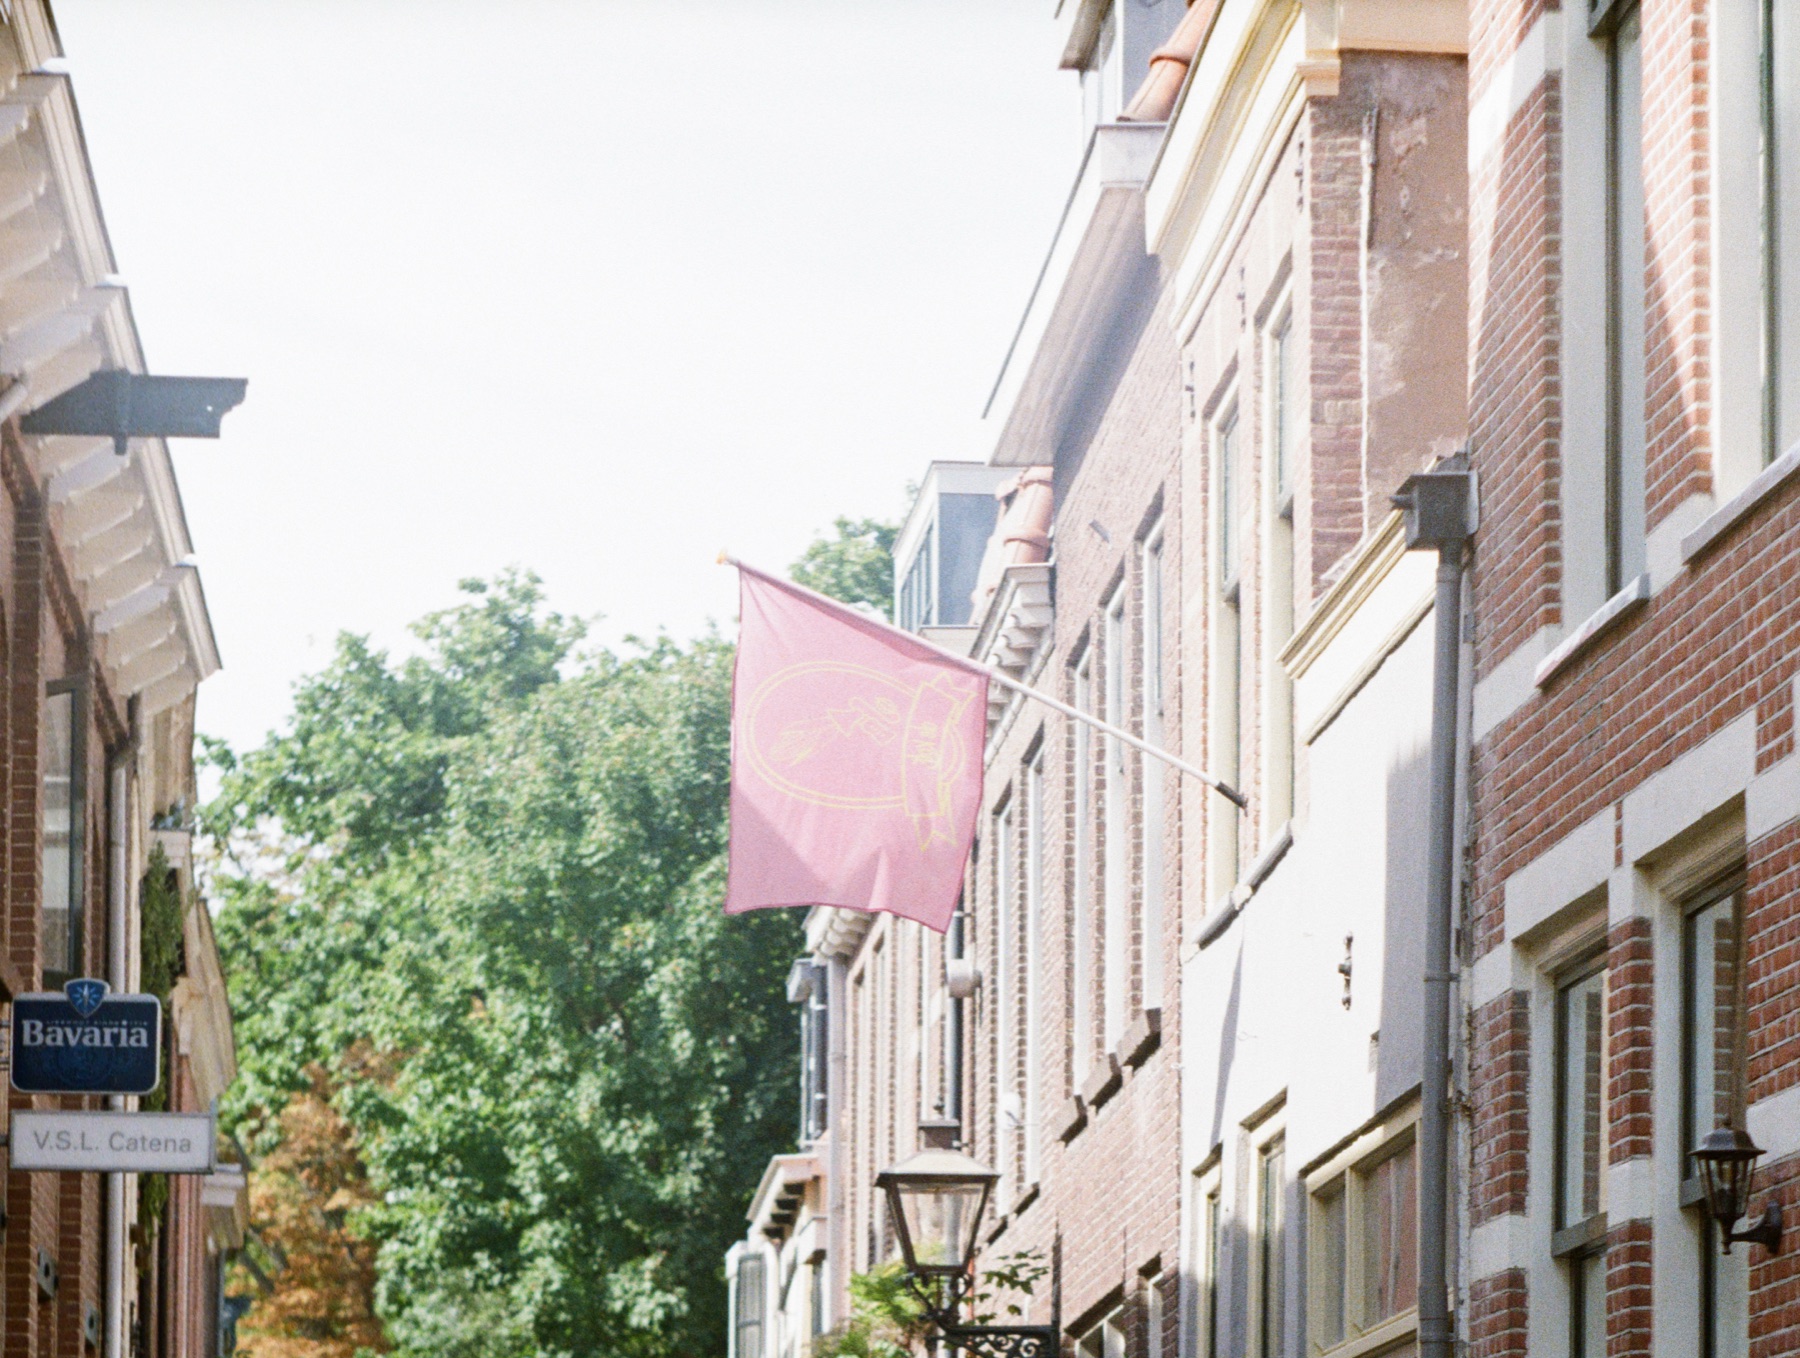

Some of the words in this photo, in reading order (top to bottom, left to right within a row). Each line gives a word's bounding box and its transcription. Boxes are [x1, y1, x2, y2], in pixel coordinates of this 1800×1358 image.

[22, 1019, 149, 1047] Bavaria
[33, 1130, 100, 1151] V.S.L.
[108, 1131, 192, 1153] Catena
